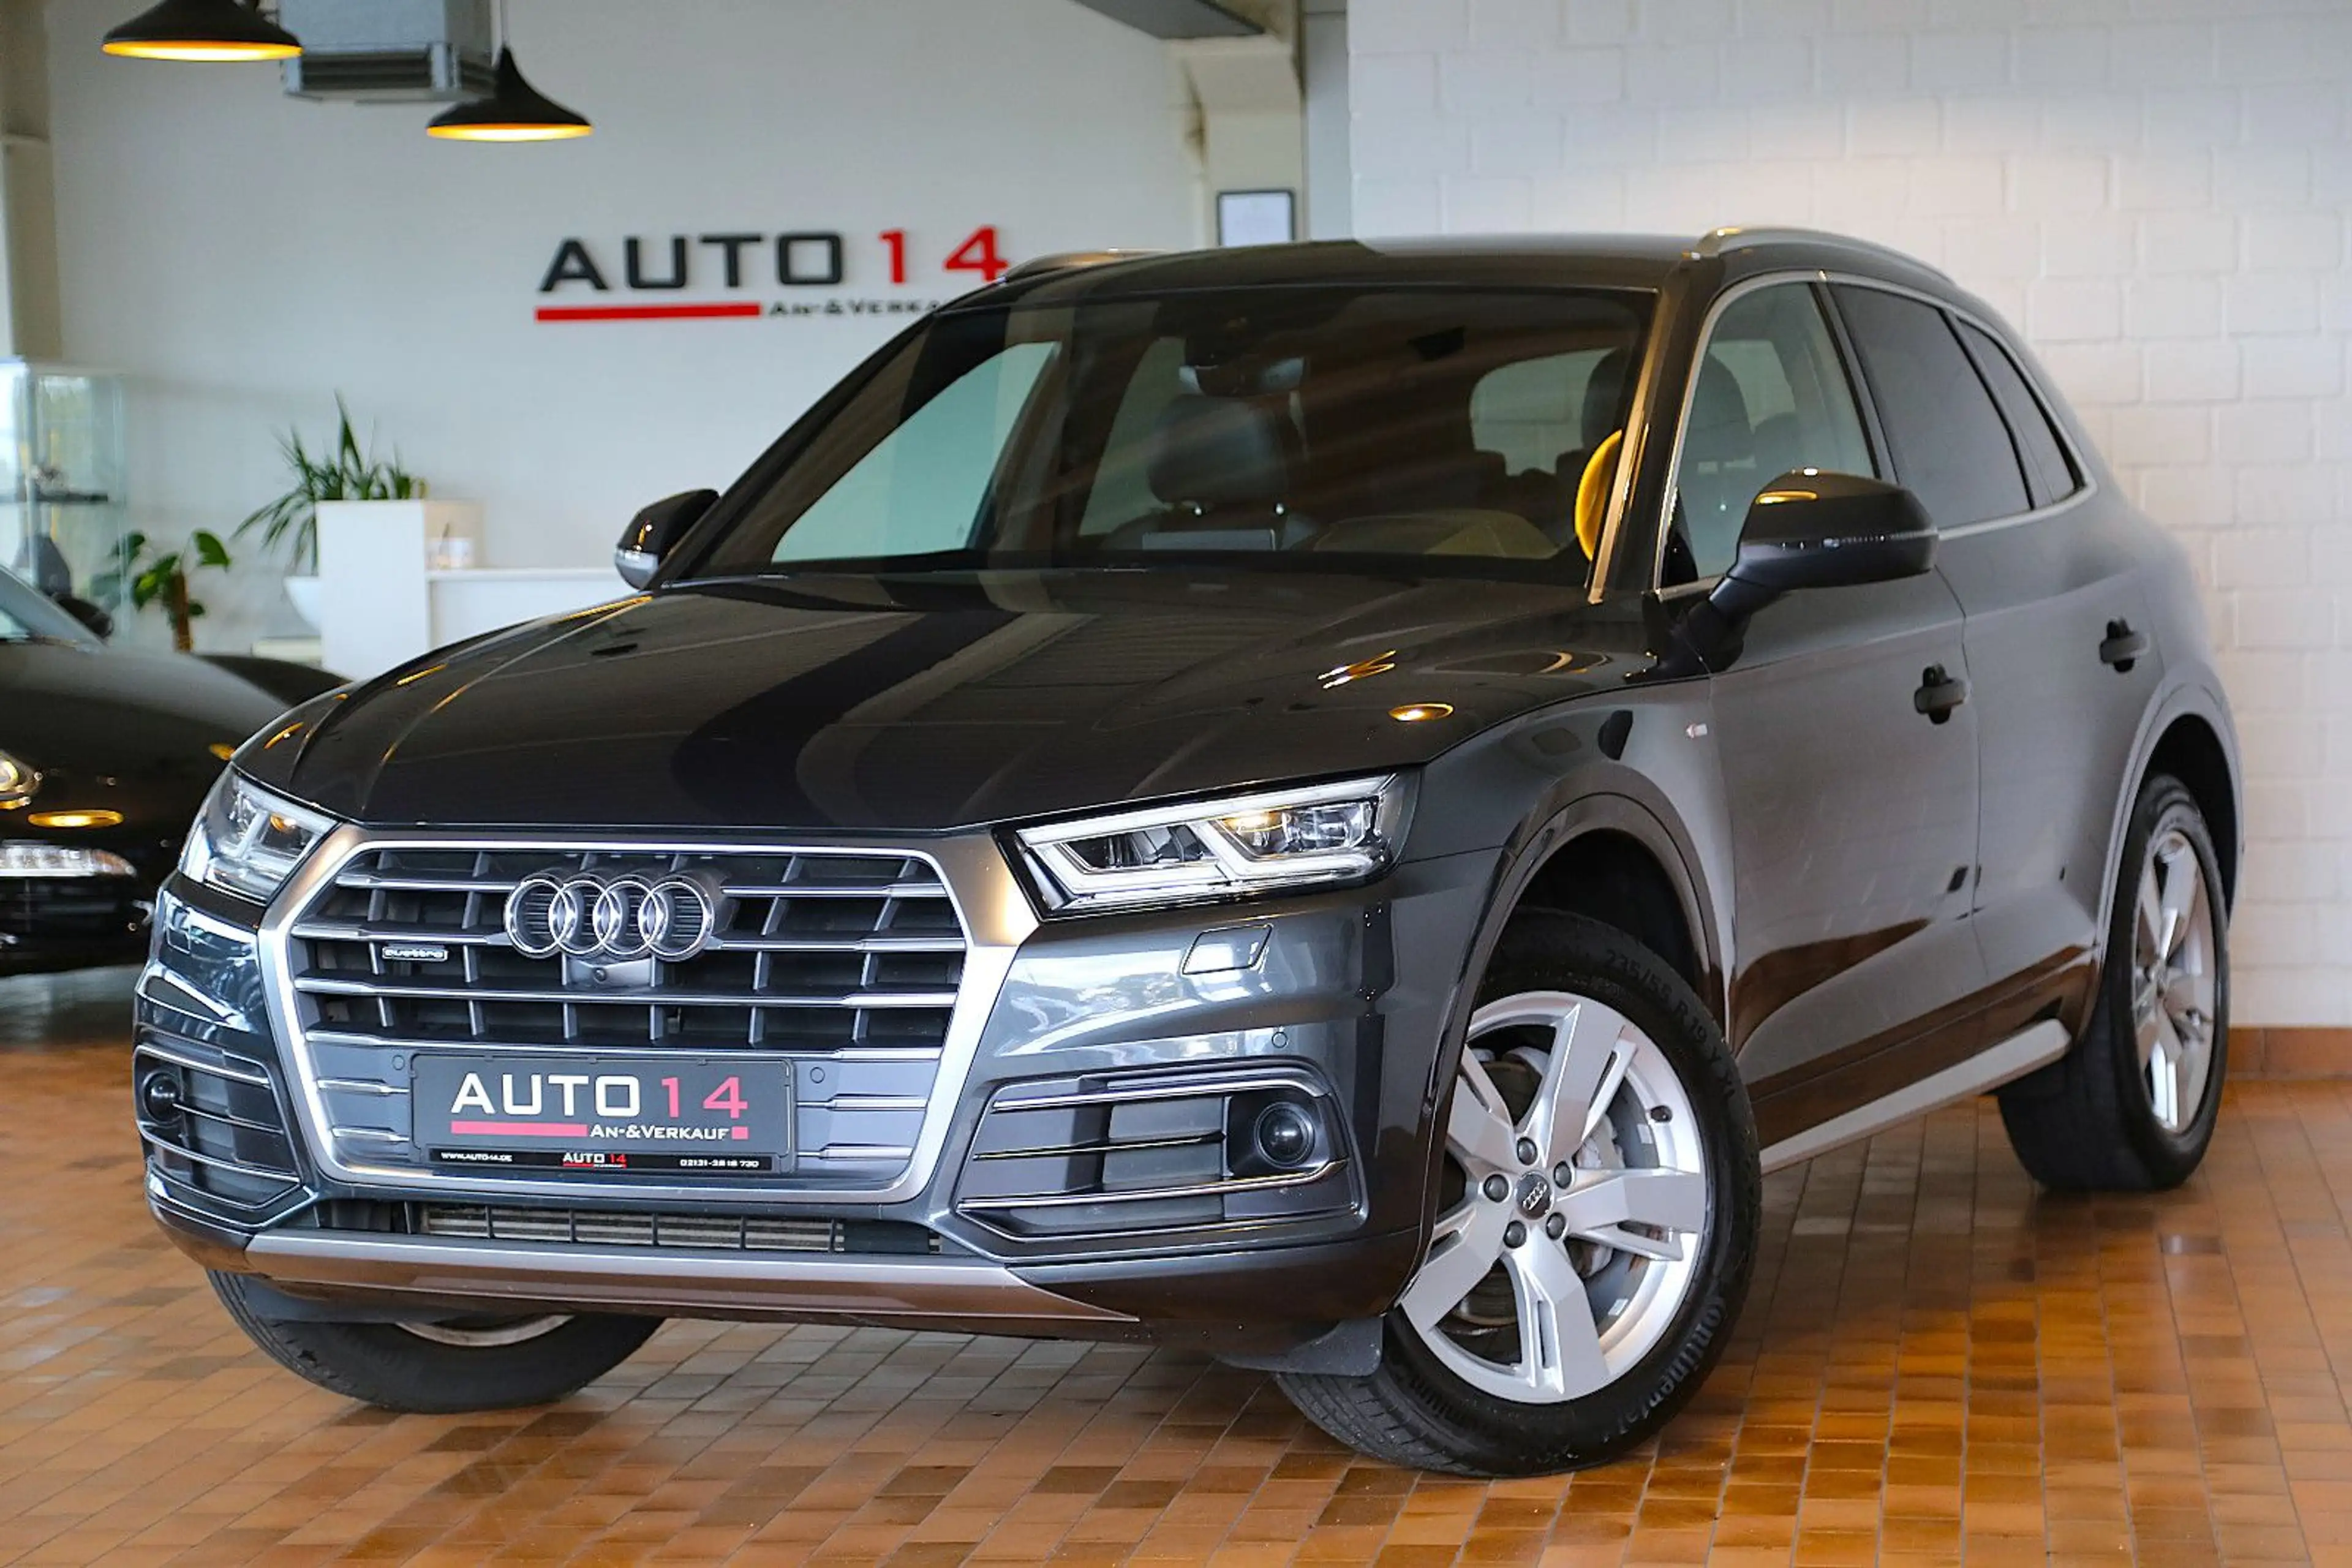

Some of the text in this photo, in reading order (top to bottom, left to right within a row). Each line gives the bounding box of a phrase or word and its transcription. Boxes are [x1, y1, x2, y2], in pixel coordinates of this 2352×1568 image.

[539, 224, 1009, 292] AUTO 14
[451, 1072, 748, 1120] AUTO 14
[563, 1152, 627, 1164] AUTO 14
